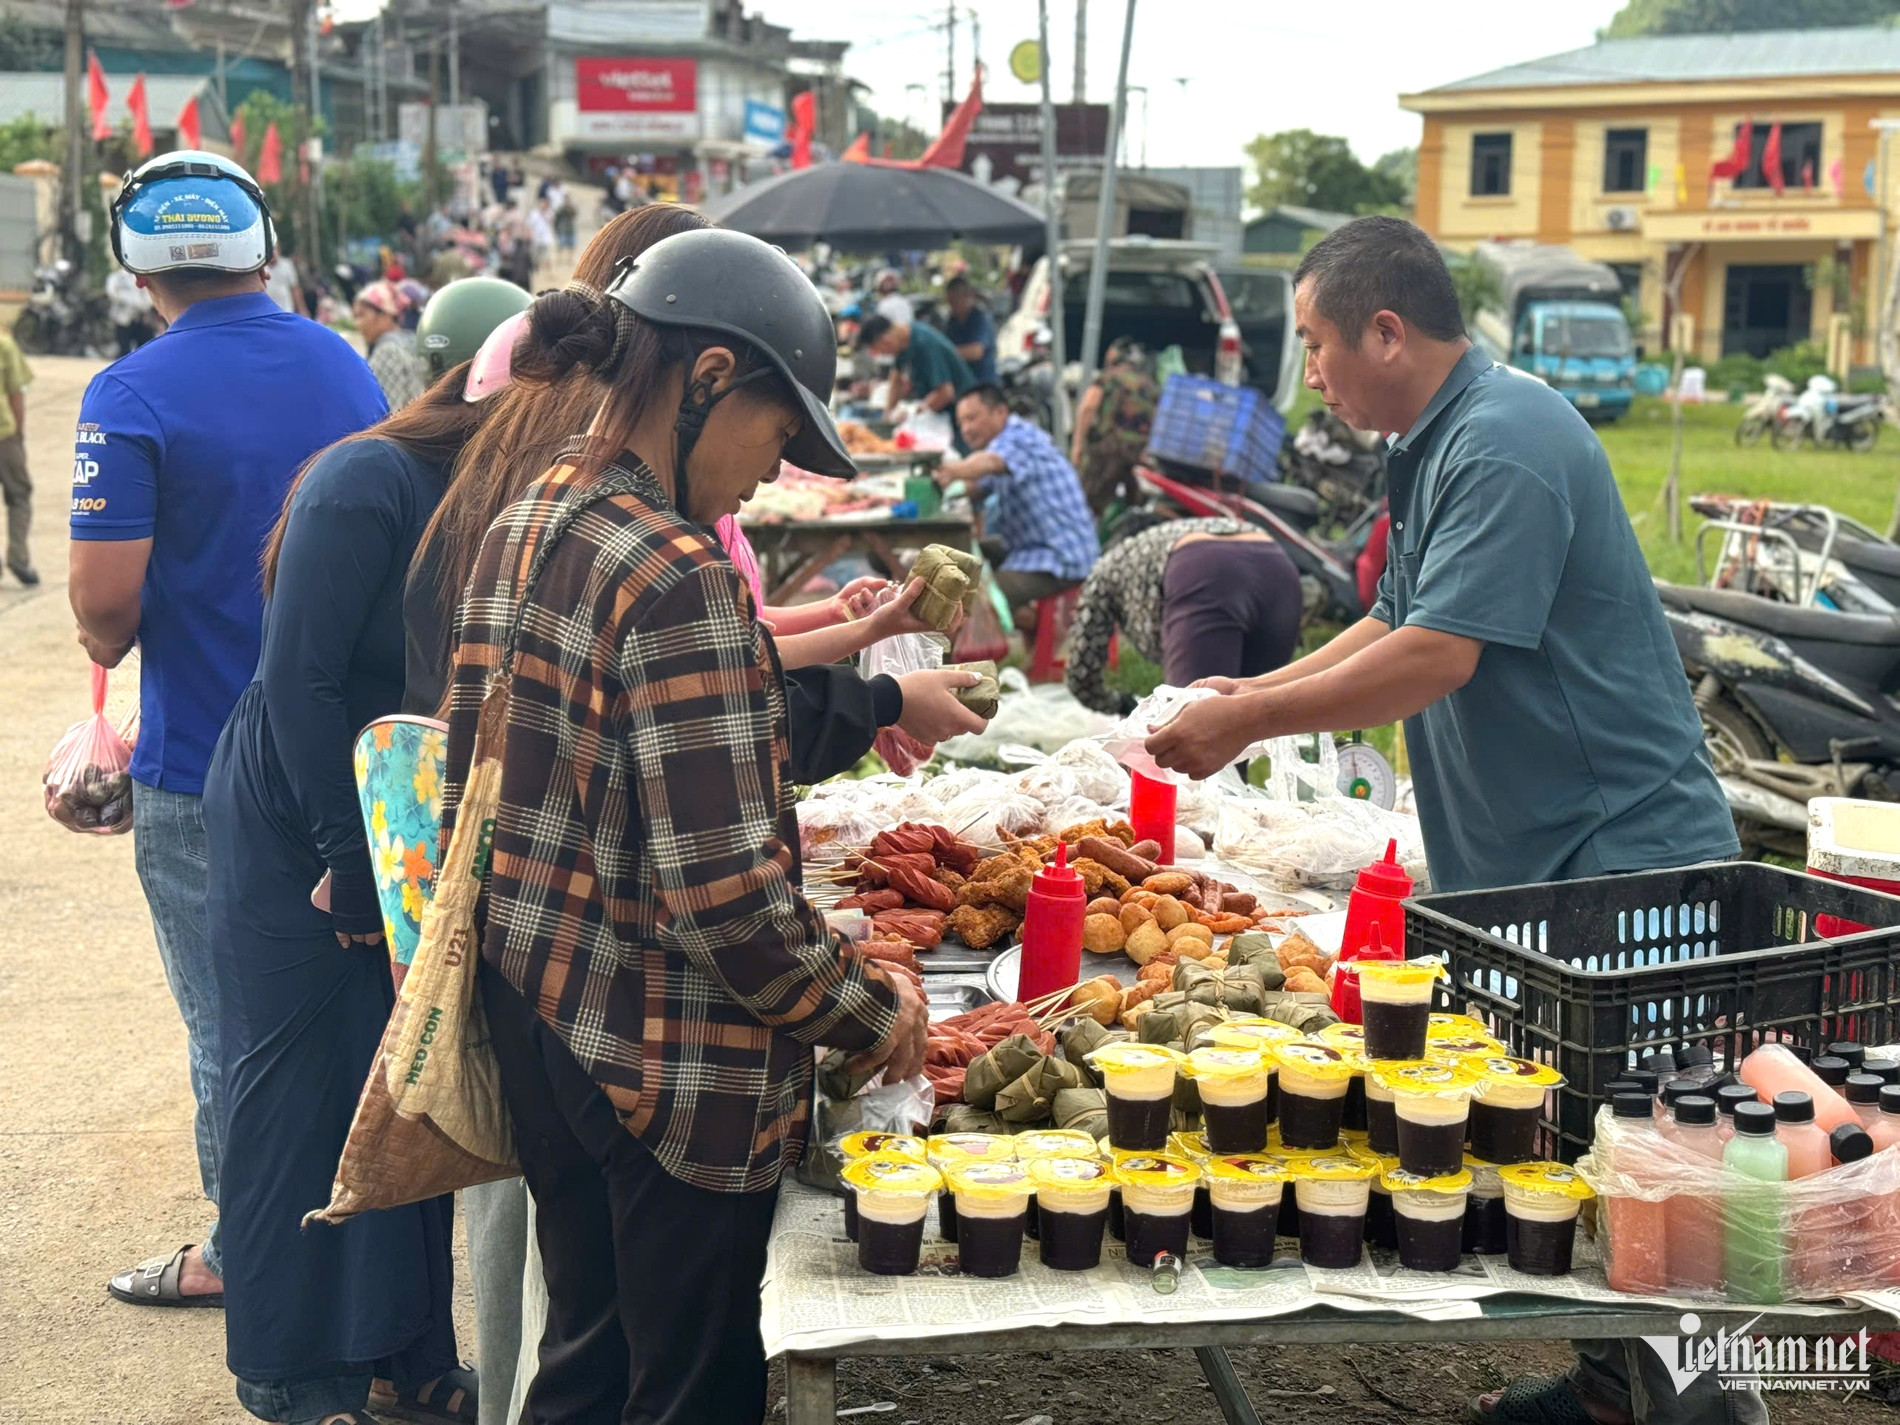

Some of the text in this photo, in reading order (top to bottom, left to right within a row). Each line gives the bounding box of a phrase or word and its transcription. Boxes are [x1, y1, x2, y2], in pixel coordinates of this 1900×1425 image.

[80, 432, 107, 445] BLACK
[444, 928, 469, 967] U21
[405, 1007, 443, 1085] HEO CON
